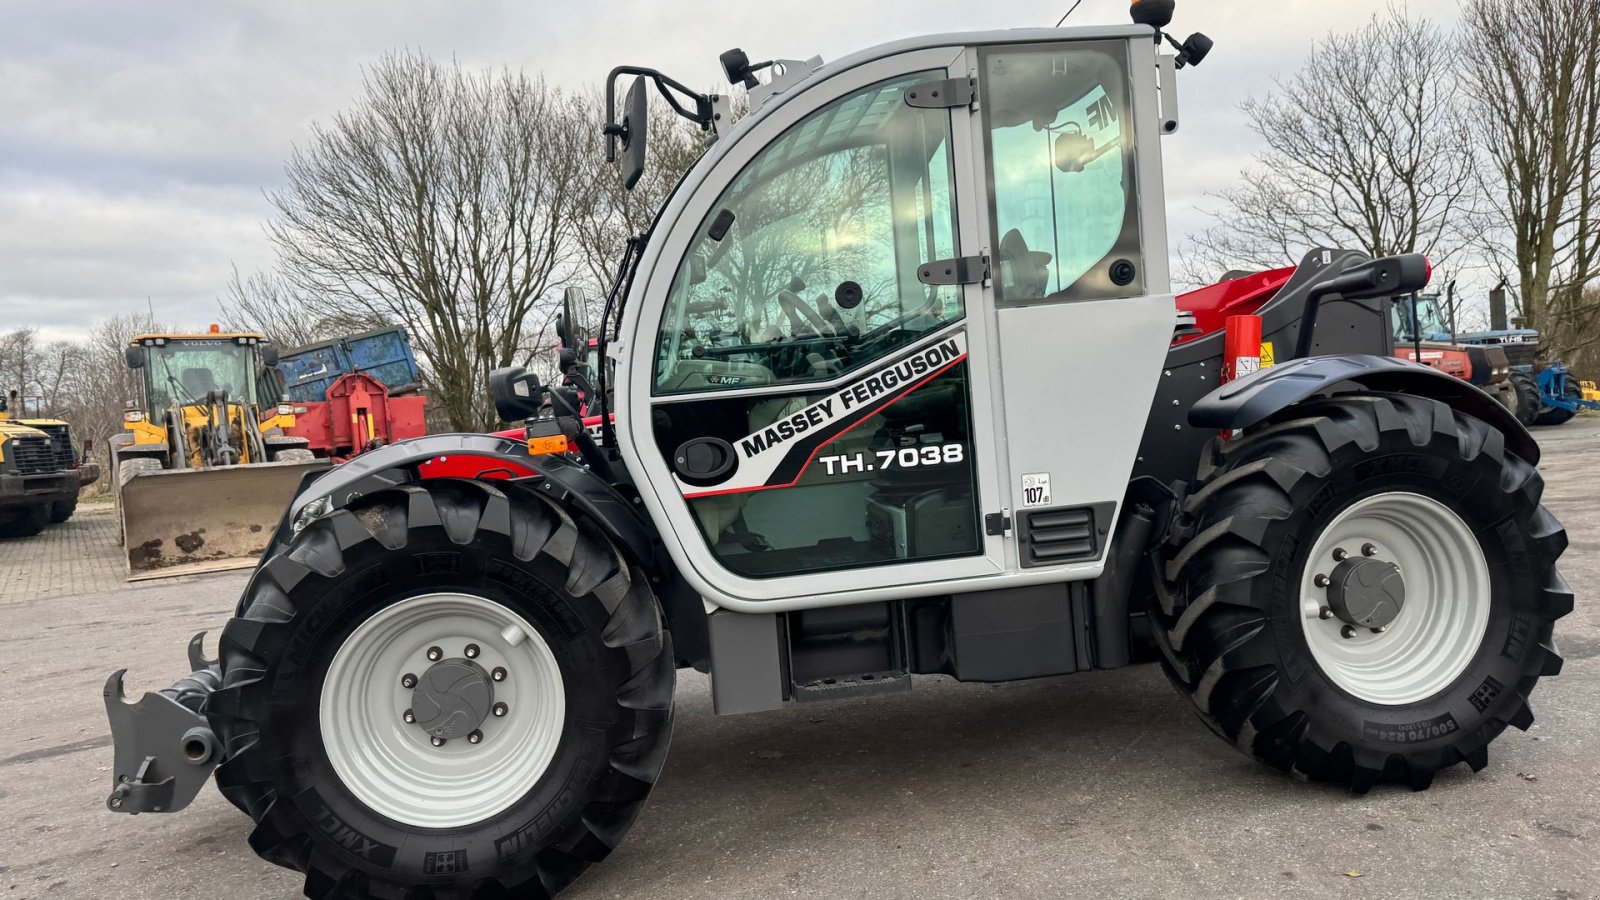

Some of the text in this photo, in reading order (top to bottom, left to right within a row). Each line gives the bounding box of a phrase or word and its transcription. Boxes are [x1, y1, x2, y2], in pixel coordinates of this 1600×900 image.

[720, 376, 740, 384] MF
[741, 339, 960, 458] MASSEY FERGUSON
[819, 443, 963, 475] TH.7038
[1024, 486, 1043, 504] 107
[1408, 719, 1456, 741] 500/70
[312, 804, 379, 858] XMCL
